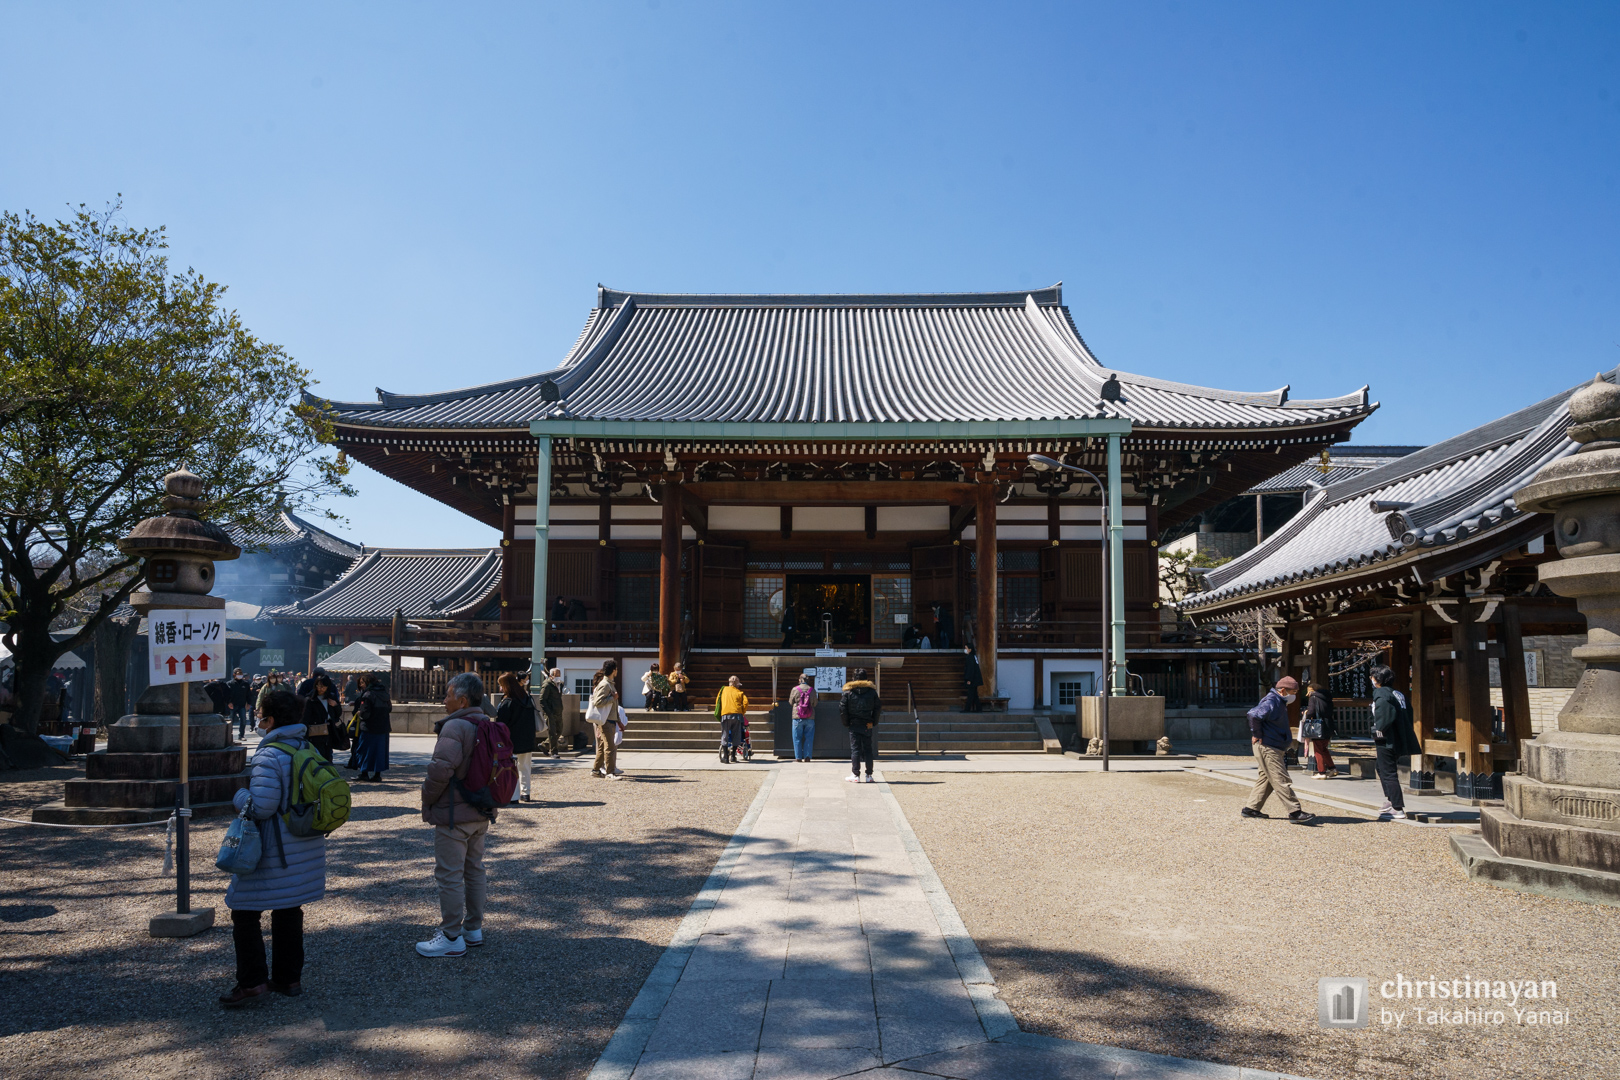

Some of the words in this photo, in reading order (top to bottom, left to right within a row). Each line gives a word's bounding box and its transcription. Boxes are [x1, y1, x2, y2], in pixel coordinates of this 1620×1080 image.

[155, 621, 220, 645] 線香・ローソク
